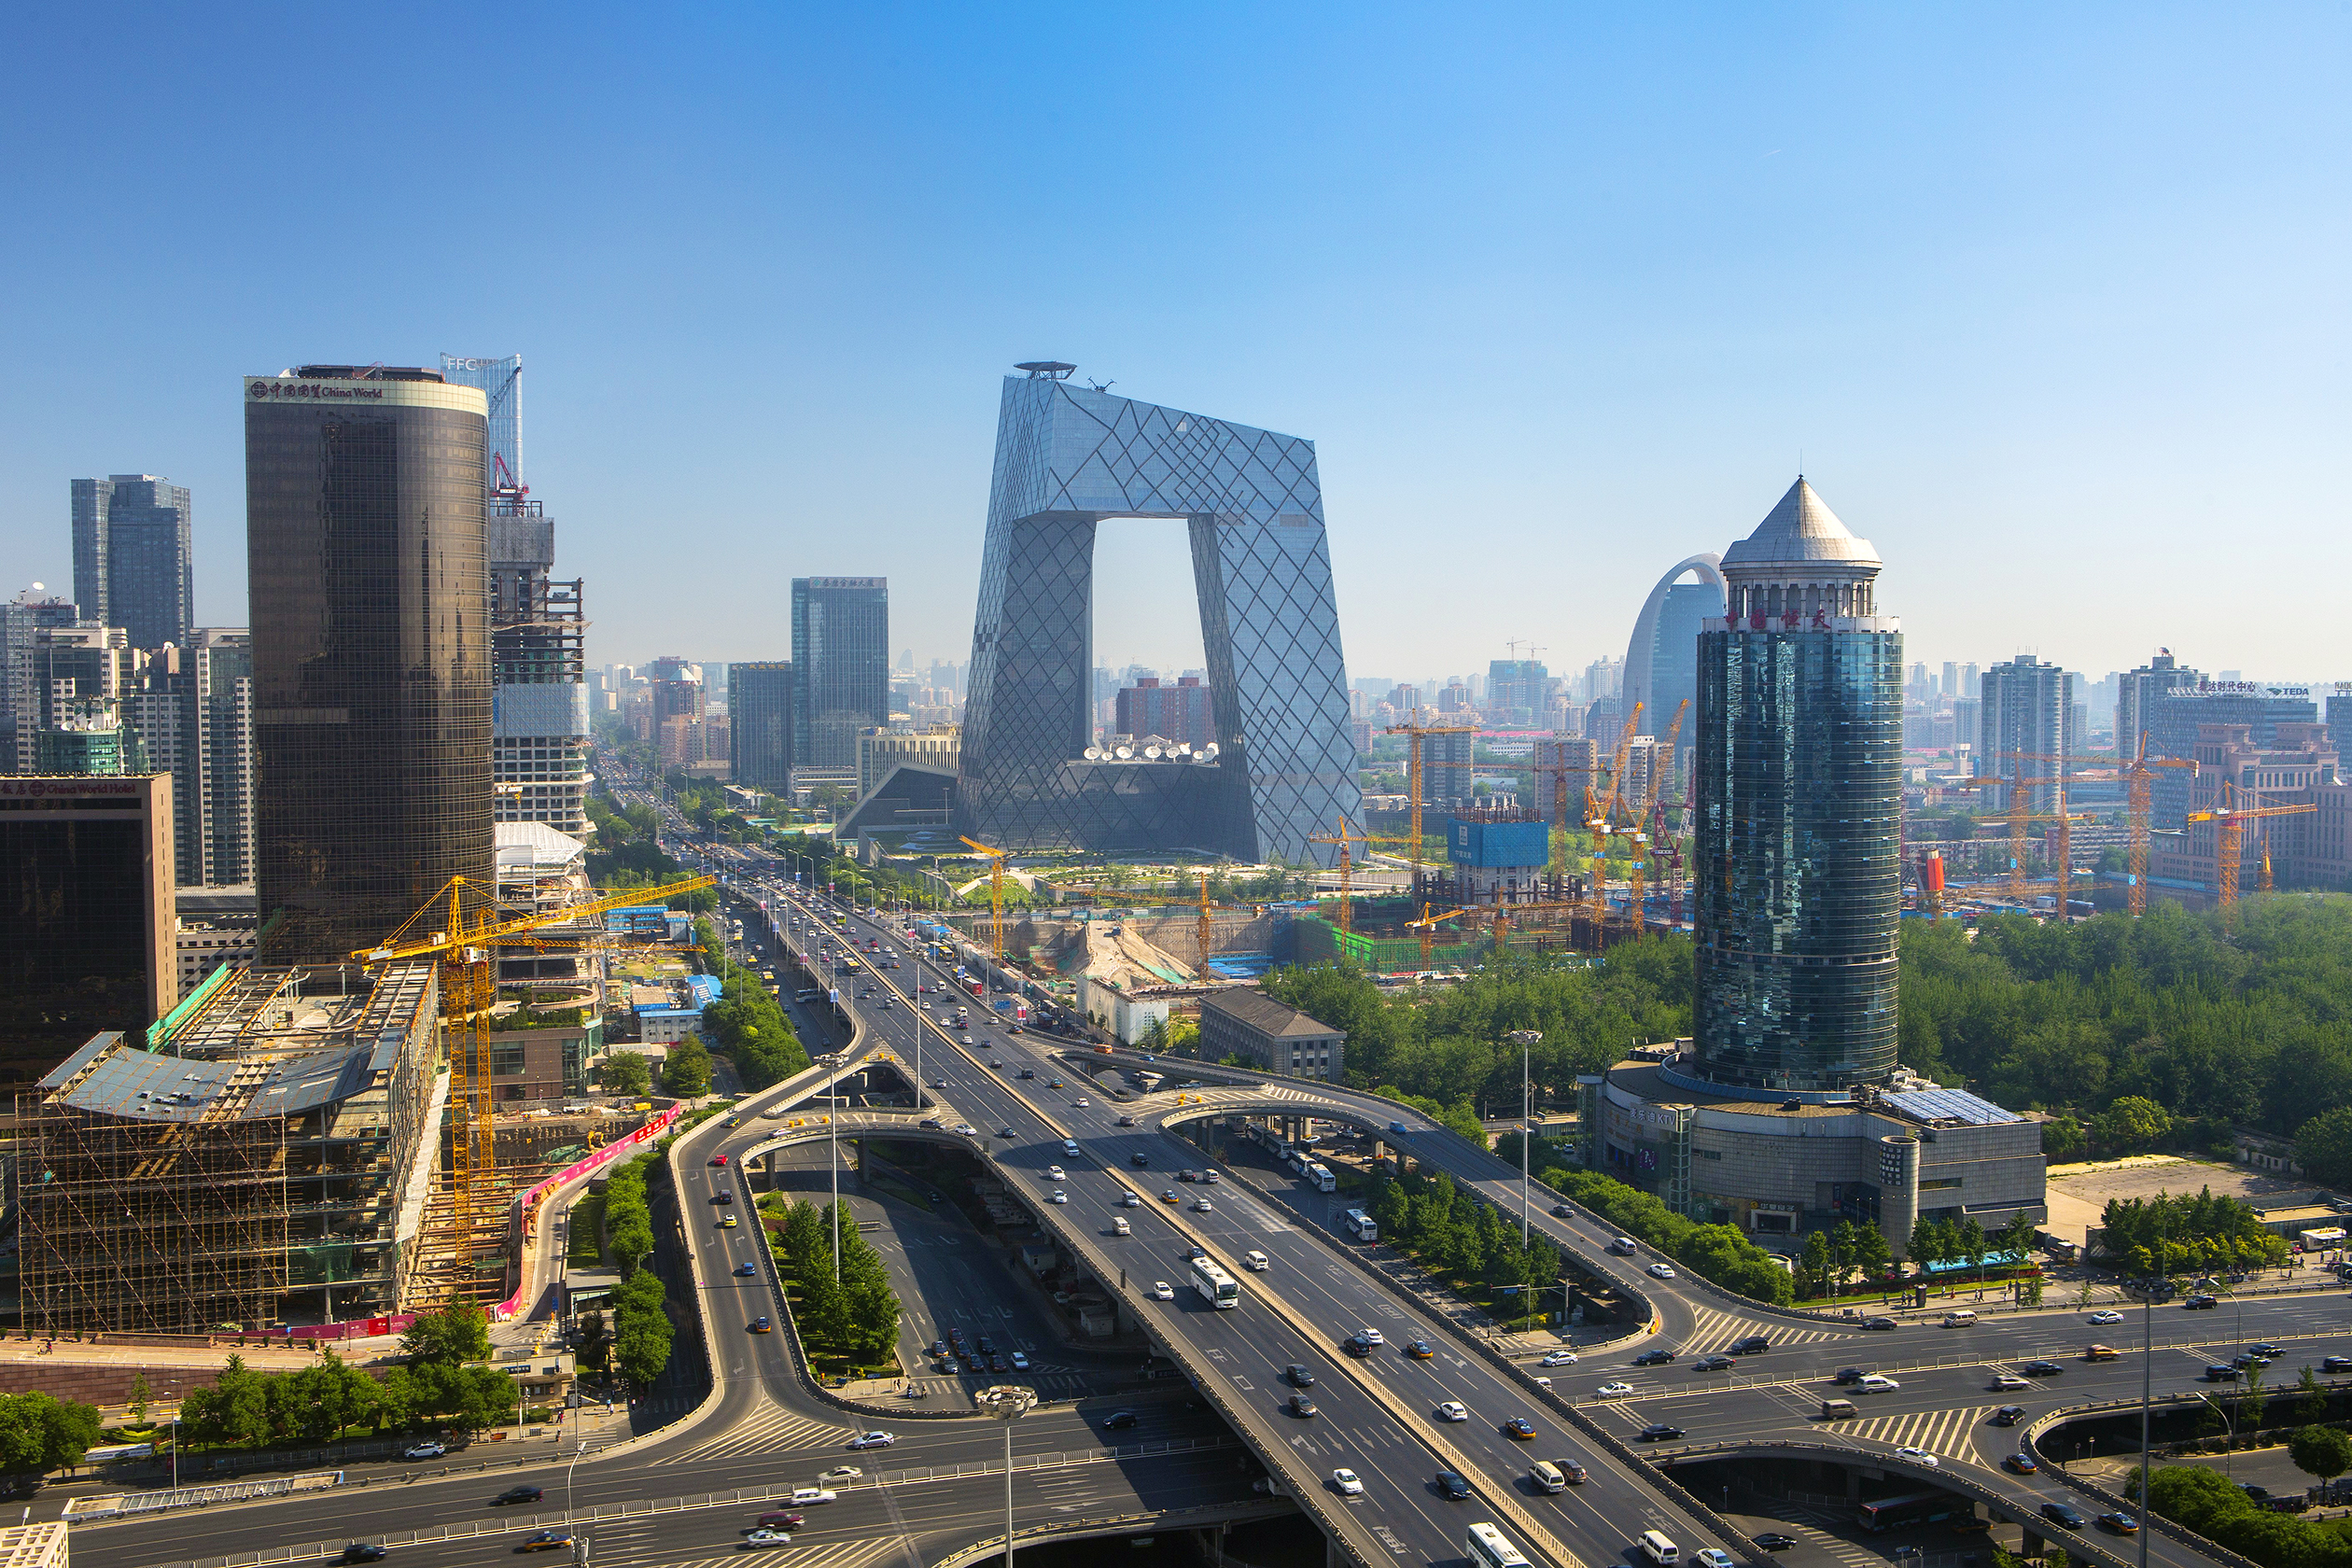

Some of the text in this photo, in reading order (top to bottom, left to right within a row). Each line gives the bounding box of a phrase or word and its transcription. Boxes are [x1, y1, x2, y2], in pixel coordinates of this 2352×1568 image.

[447, 357, 476, 371] FFC
[322, 386, 352, 399] China
[353, 387, 382, 399] World
[2198, 681, 2256, 693] 泰达时代中心
[47, 783, 77, 794] China
[77, 784, 107, 794] World
[109, 783, 136, 793] Hotel
[1658, 1113, 1676, 1126] KTV
